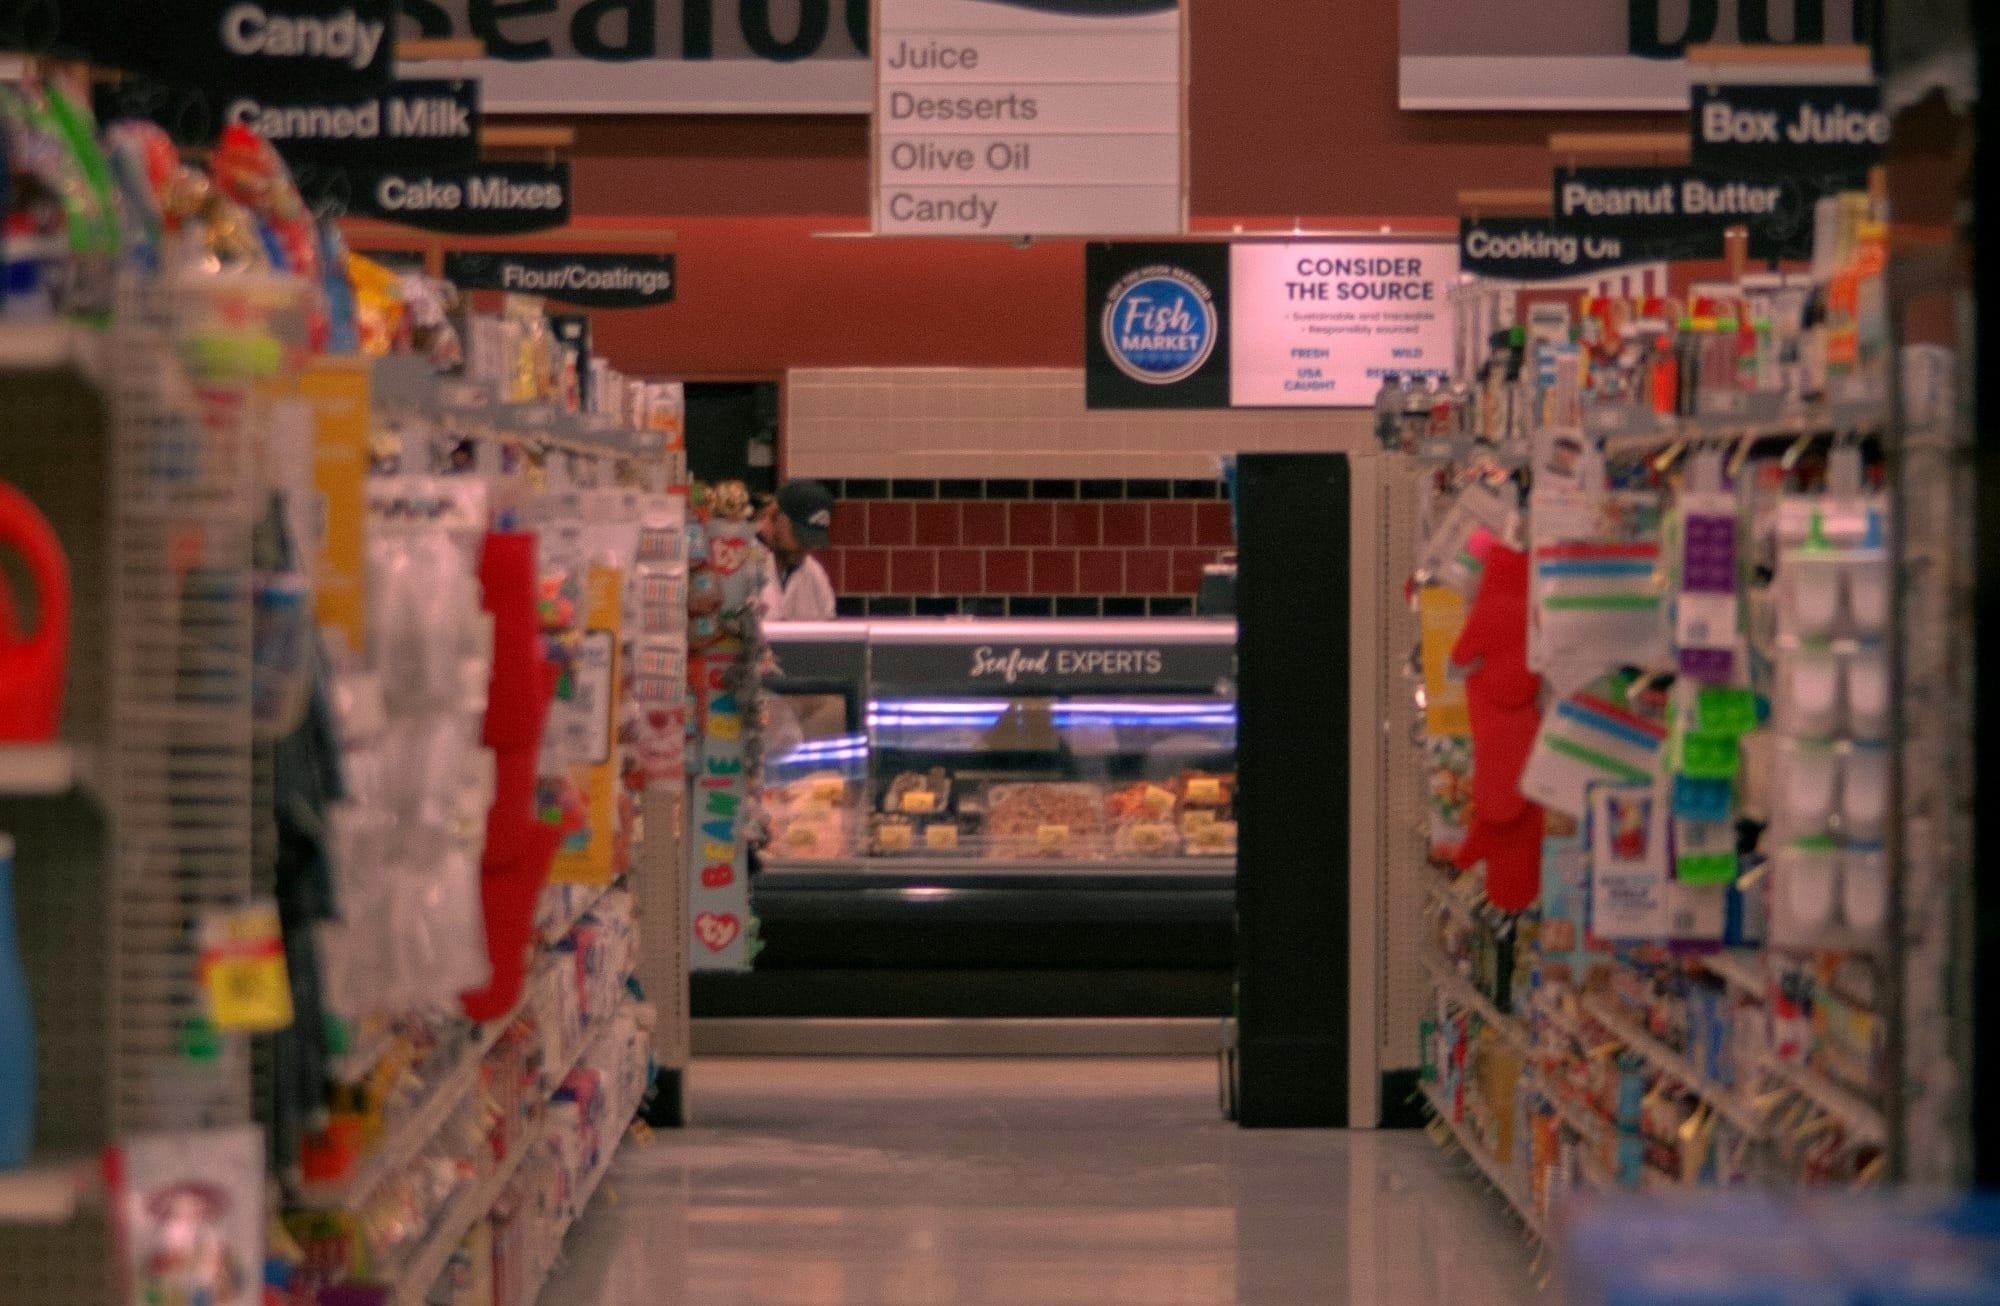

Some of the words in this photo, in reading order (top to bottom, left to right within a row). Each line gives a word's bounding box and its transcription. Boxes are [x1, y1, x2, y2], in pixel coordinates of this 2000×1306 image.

[221, 4, 385, 70] Candy
[888, 41, 979, 70] Juice
[226, 98, 381, 139] Canned
[388, 97, 471, 138] Milk
[890, 91, 1038, 121] Desserts
[1702, 103, 1778, 143] Box
[1786, 103, 1892, 144] Juice
[890, 142, 975, 172] Olive
[986, 142, 1030, 172] Oil
[379, 176, 462, 210] Cake
[467, 176, 563, 210] Mixes
[1562, 182, 1675, 216] Peanut
[1681, 181, 1780, 214] Butter
[889, 193, 998, 228] Candy
[1466, 230, 1578, 265] Cooking
[502, 264, 671, 295] Flour/Coatings
[1296, 258, 1422, 276] CONSIDER
[1285, 282, 1330, 300] THE
[1336, 282, 1434, 300] SOURCE
[1122, 296, 1199, 335] Fish
[1121, 335, 1200, 351] MARKET
[1291, 347, 1330, 358] FRESH
[1391, 347, 1424, 358] WILD
[1284, 380, 1336, 391] CAUGHT
[1297, 368, 1322, 378] USA
[970, 646, 1050, 684] Seafood
[1055, 649, 1163, 675] EXPERTS
